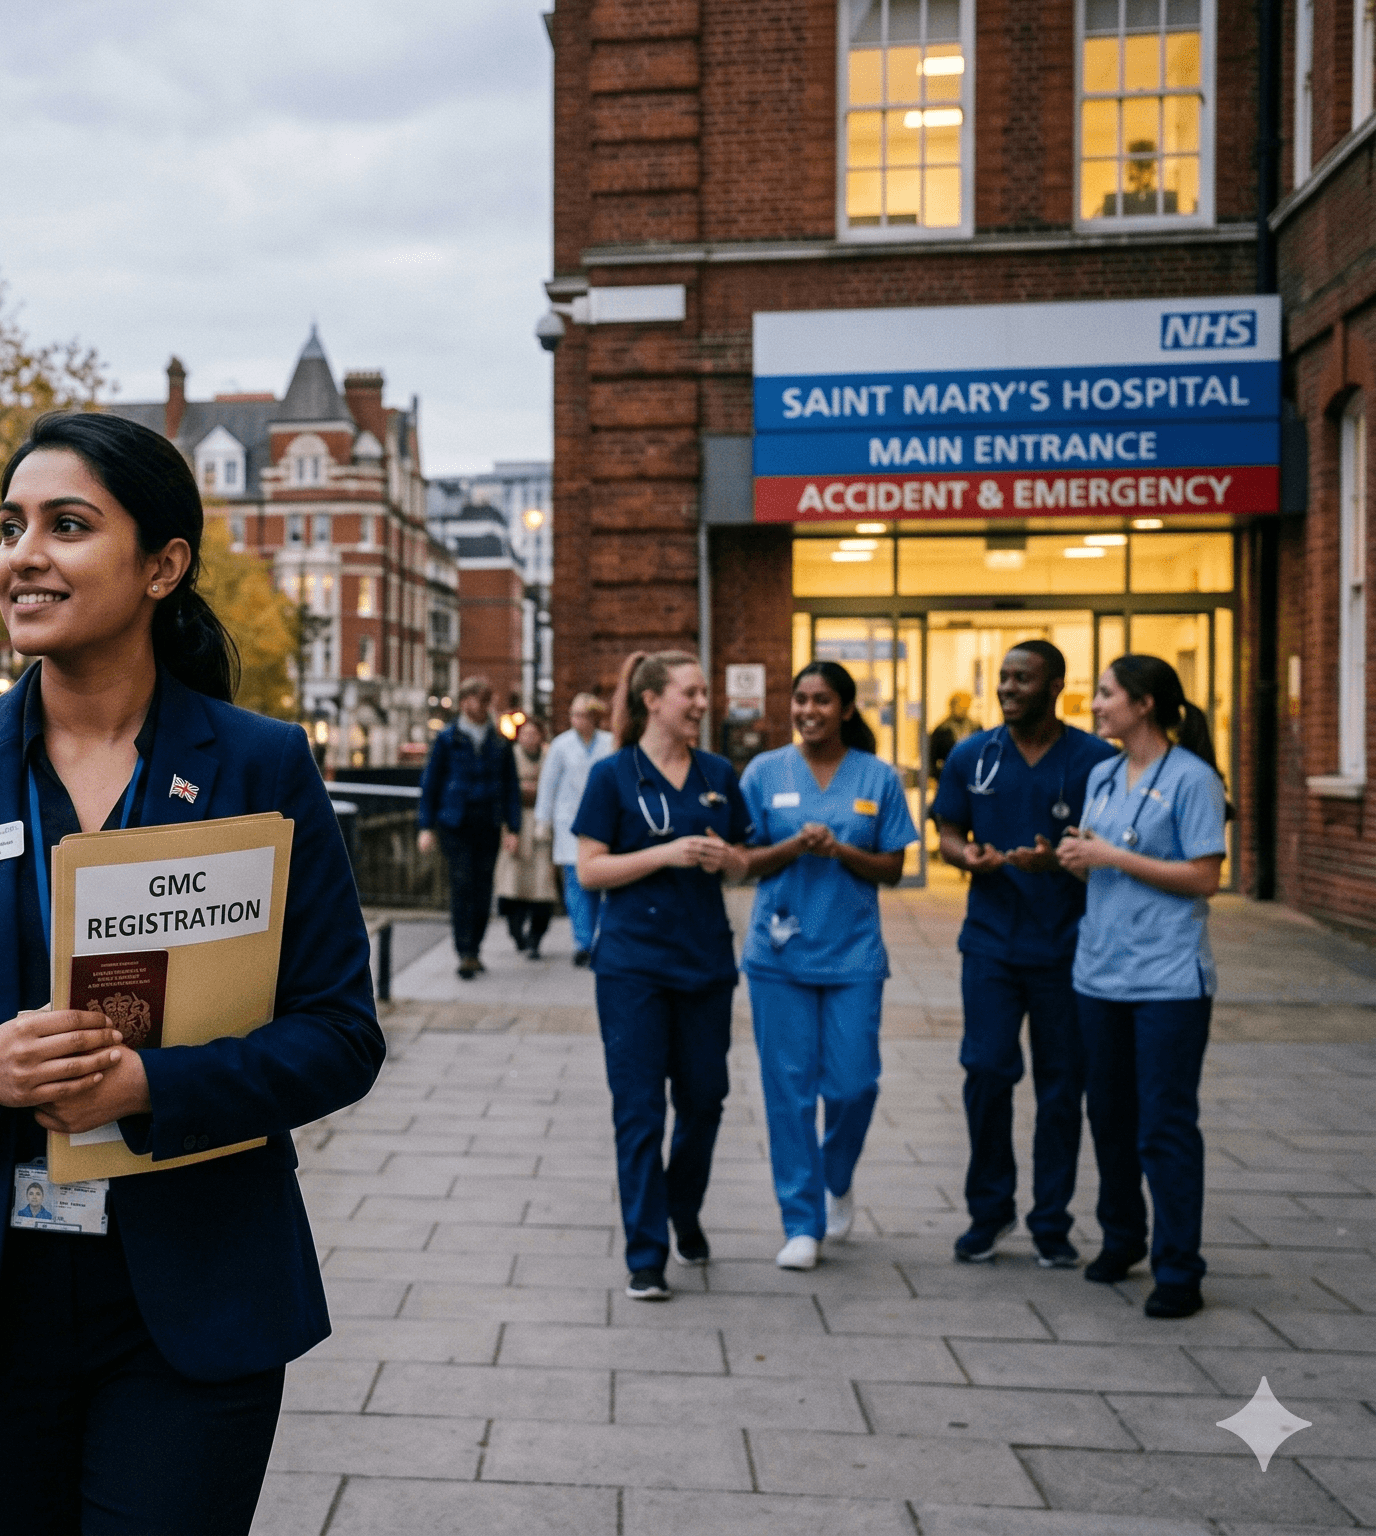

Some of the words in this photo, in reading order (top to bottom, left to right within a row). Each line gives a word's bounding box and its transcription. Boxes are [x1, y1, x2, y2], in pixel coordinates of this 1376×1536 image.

[1164, 313, 1253, 348] NHS
[782, 384, 892, 419] SAINT
[903, 380, 1050, 415] MARY'S
[1062, 375, 1250, 410] HOSPITAL
[869, 436, 963, 467] MAIN
[974, 431, 1157, 464] ENTRANCE
[797, 480, 970, 513] ACCIDENT
[976, 479, 1004, 510] &
[1013, 475, 1232, 509] EMERGENCY
[148, 871, 207, 897] GMC
[87, 899, 261, 940] REGISTRATION
